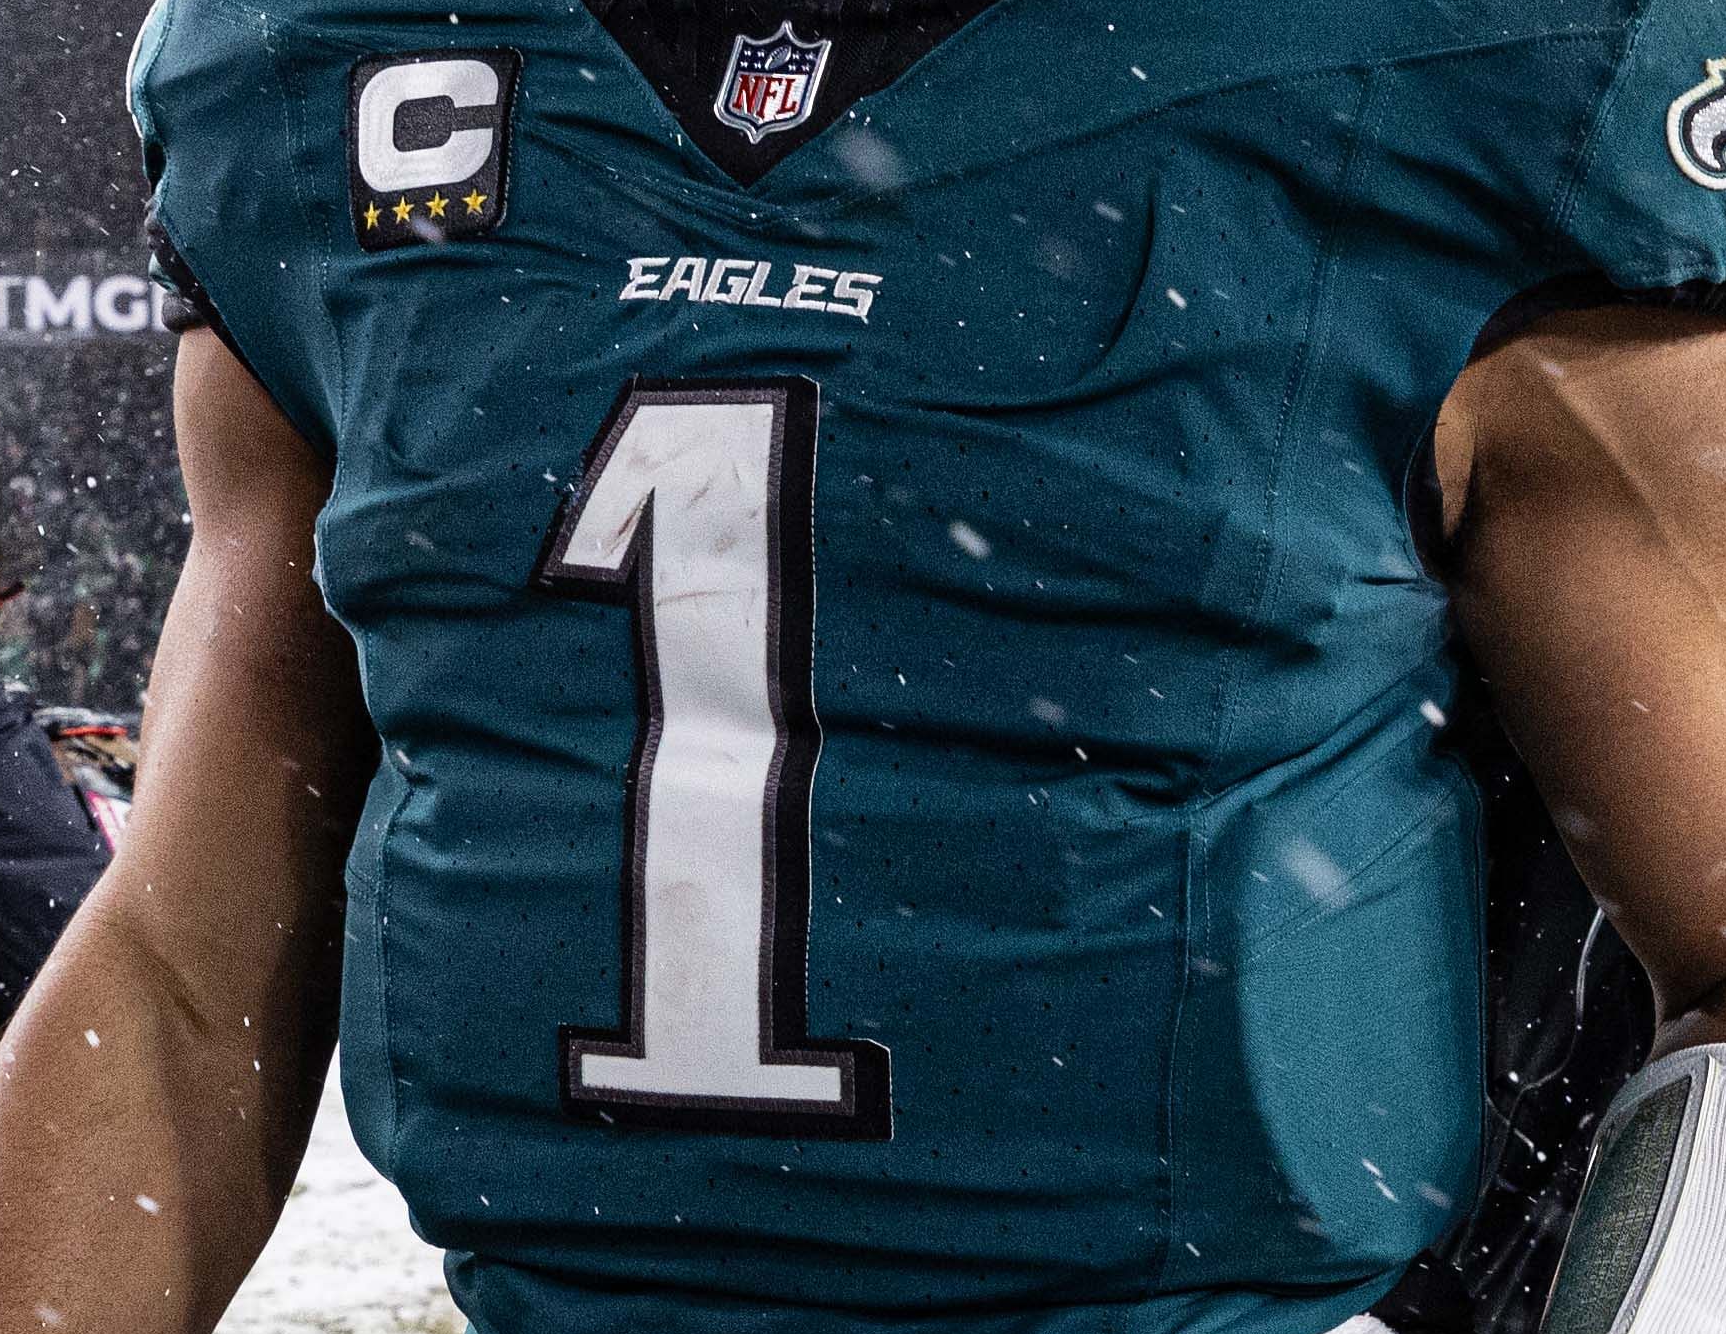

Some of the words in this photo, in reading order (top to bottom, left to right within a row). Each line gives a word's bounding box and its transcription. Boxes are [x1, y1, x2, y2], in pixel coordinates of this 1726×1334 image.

[358, 58, 499, 193] C
[732, 75, 798, 121] NFL
[618, 255, 884, 320] EAGLES
[541, 387, 857, 1118] 1
